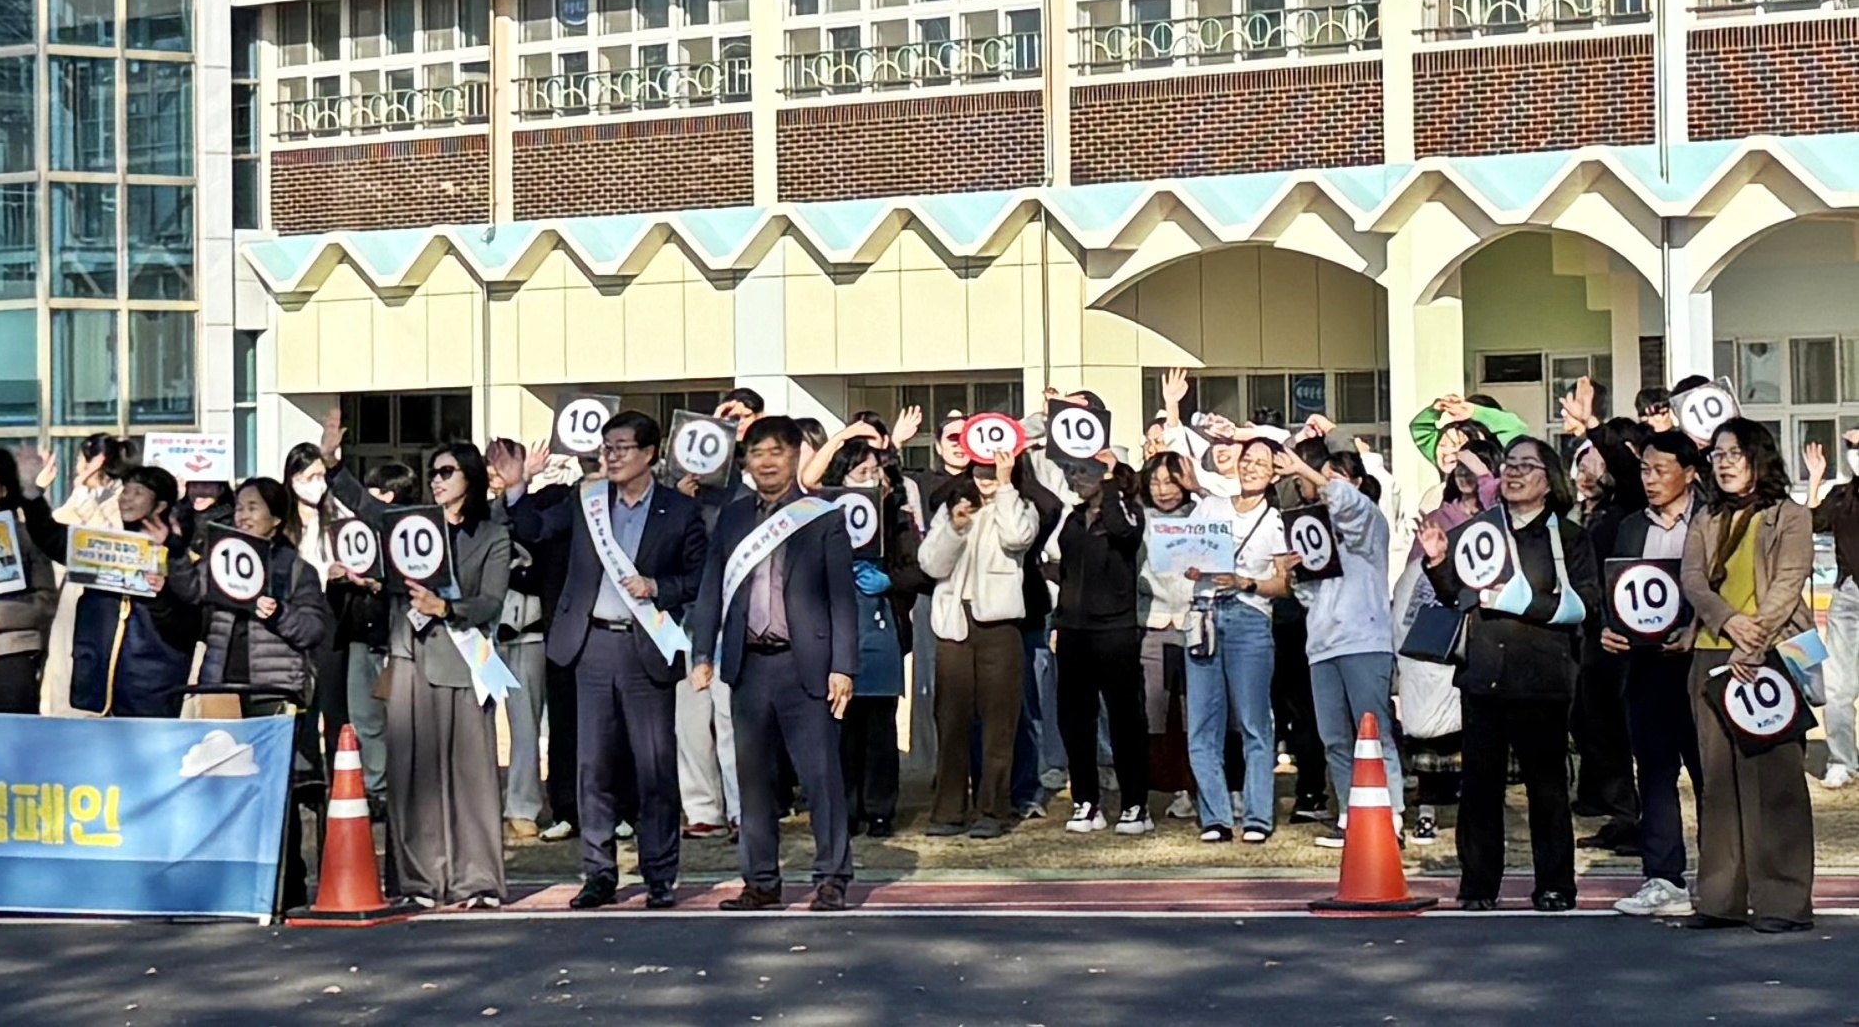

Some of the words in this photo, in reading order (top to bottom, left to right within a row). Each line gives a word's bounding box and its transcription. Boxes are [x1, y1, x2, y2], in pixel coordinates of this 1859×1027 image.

[570, 409, 601, 433] 10
[1689, 396, 1723, 425] 10
[687, 429, 720, 457] 10
[976, 426, 1004, 443] 10
[1061, 417, 1095, 440] 10
[344, 531, 369, 557] 10
[399, 528, 433, 558] 10
[1295, 524, 1323, 556] 10
[1461, 530, 1495, 570] 10
[221, 548, 254, 580] 10
[1624, 577, 1668, 611] 10
[1735, 676, 1781, 716] 10
